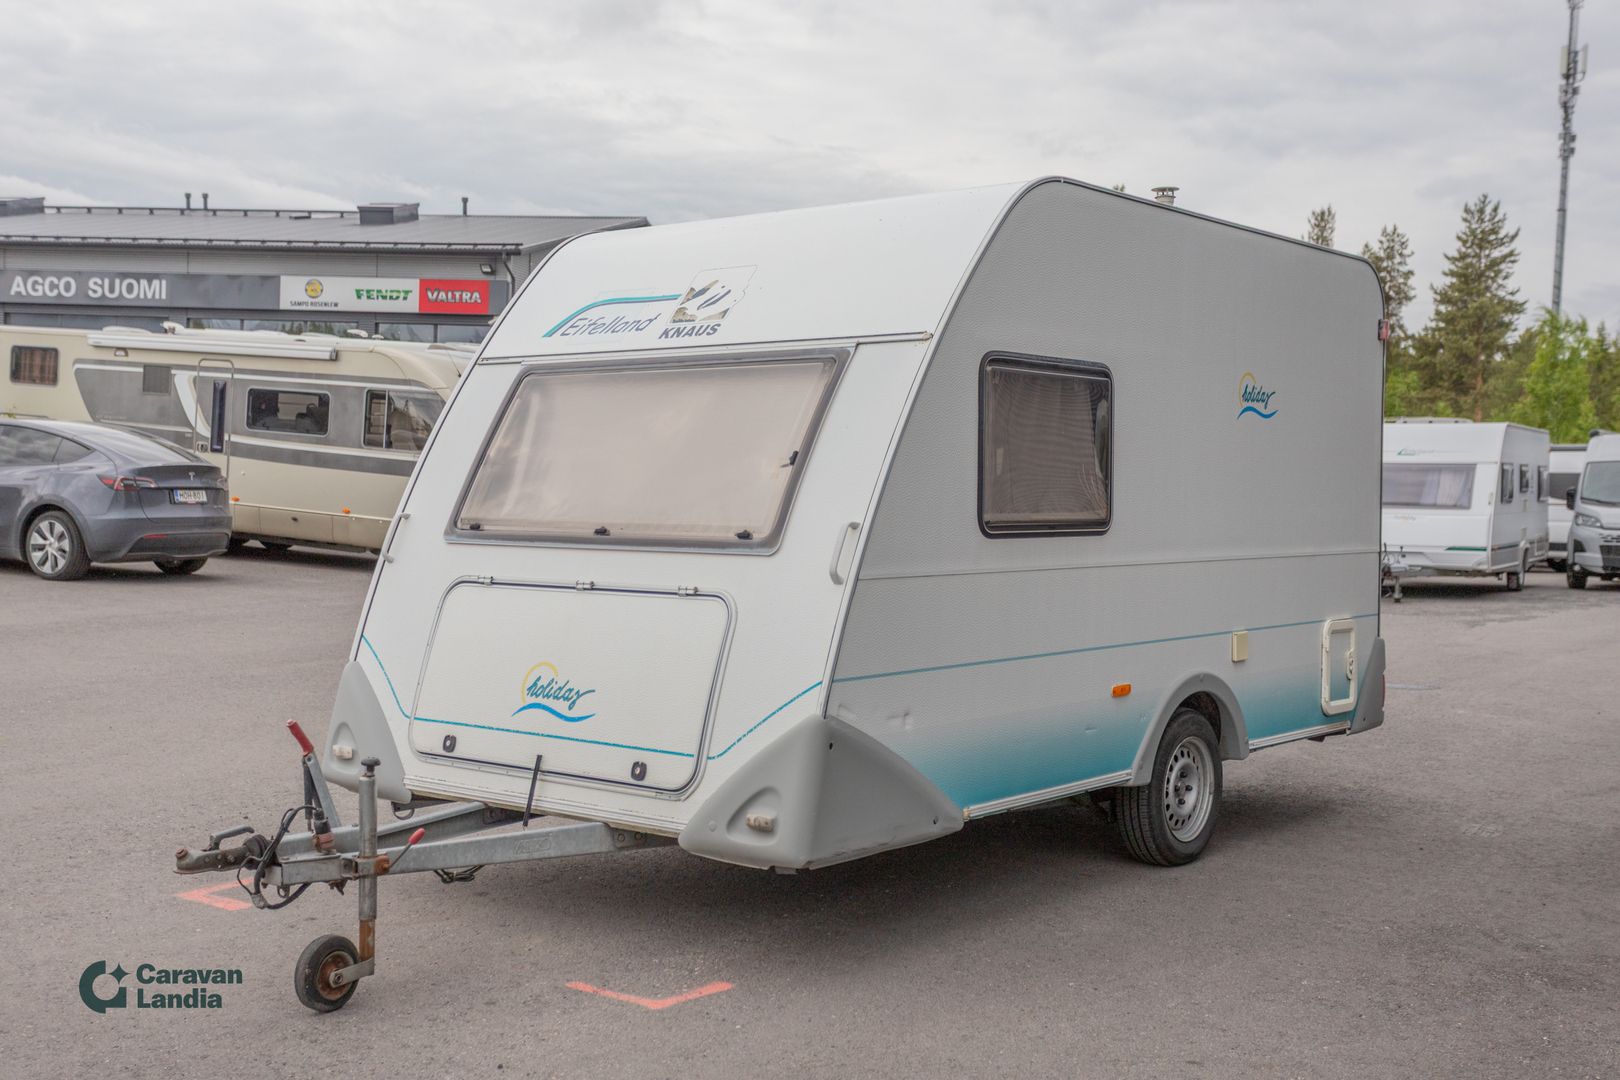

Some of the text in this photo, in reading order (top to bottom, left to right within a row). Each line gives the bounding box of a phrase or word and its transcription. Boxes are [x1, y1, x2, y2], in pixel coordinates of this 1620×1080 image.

[10, 275, 167, 300] AGCO SUOMI
[355, 288, 413, 301] FENDT
[426, 287, 482, 304] VALTRA
[560, 312, 662, 337] Eifelland
[658, 323, 722, 340] KNAUS
[1241, 384, 1276, 410] holiday
[526, 675, 596, 711] holiday
